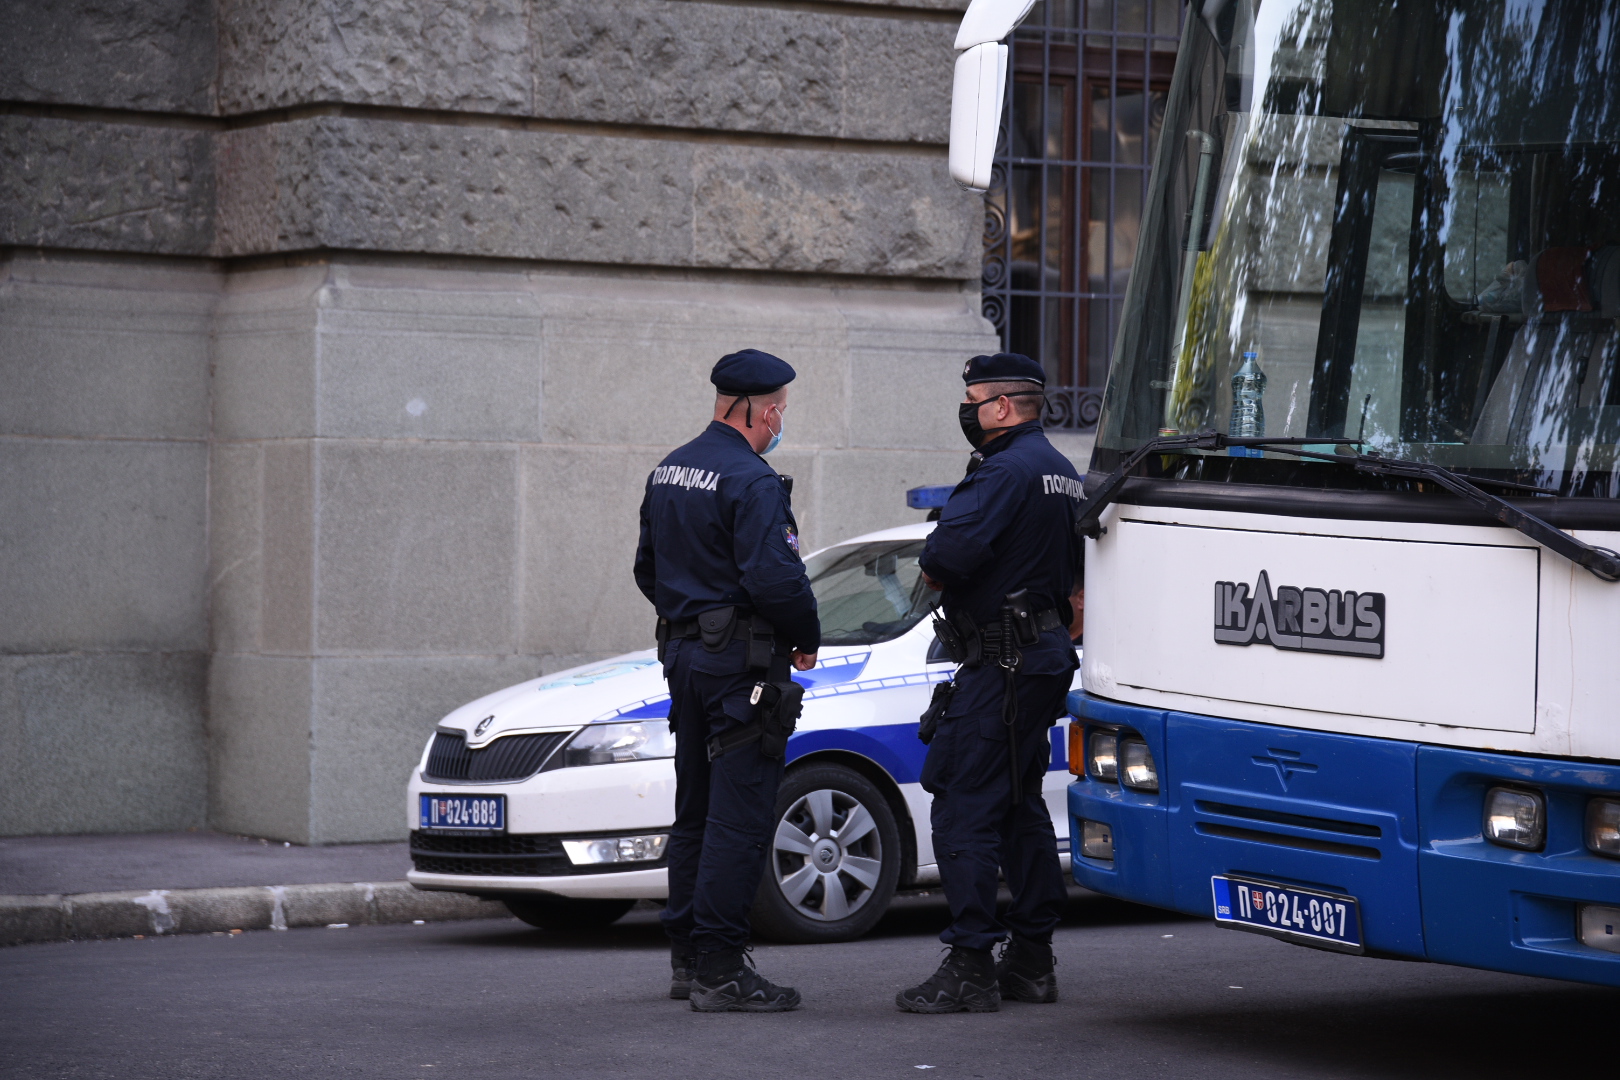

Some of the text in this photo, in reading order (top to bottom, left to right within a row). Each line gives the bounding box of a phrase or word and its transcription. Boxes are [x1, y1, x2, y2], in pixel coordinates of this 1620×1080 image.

[652, 465, 721, 491] ПОЛИЦИЈА
[1042, 474, 1088, 502] ПОЛИЦИ
[1214, 569, 1385, 654] IKARBUS
[1217, 905, 1230, 915] SRB
